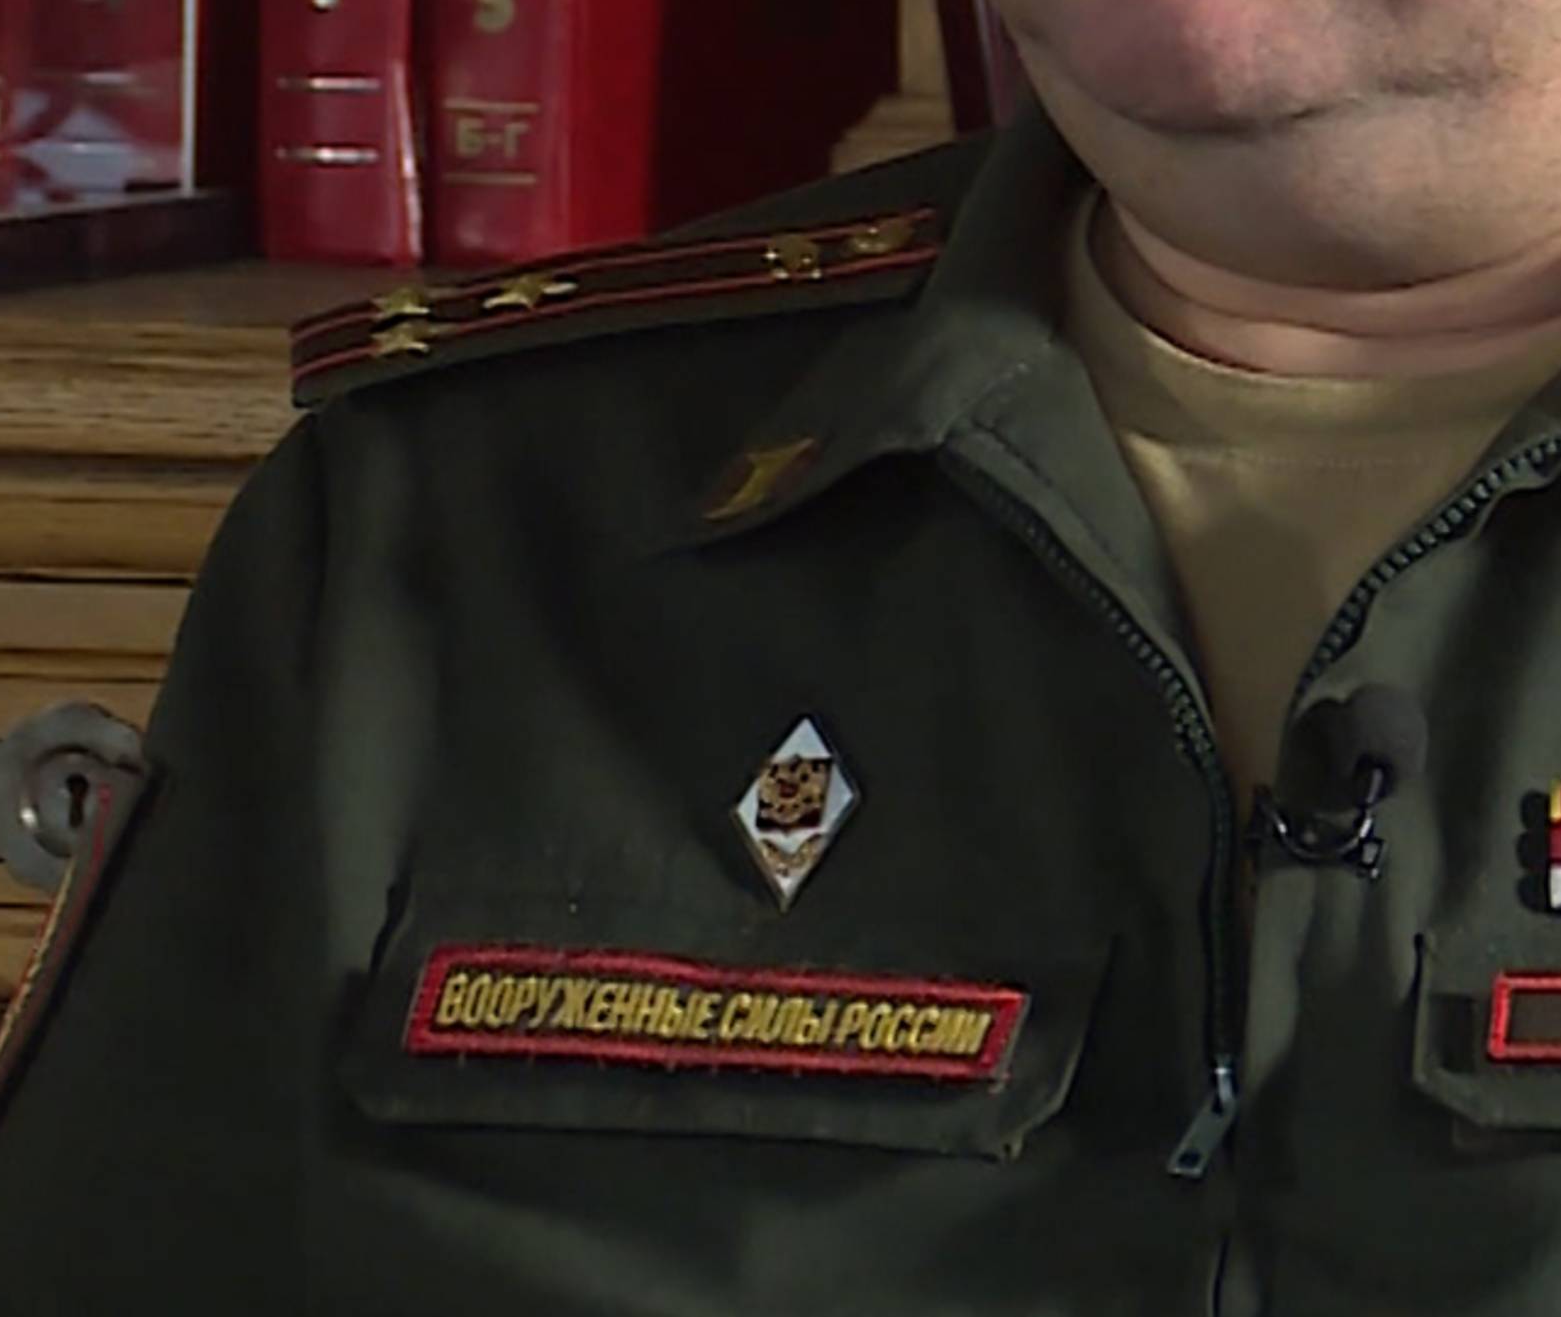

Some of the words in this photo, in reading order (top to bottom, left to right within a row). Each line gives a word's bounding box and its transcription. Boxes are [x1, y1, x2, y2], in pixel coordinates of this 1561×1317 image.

[436, 971, 723, 1040] ВООРУЖЕННЫЕ
[720, 991, 836, 1045] СИЛЫ
[837, 1001, 994, 1056] РОССИИ
